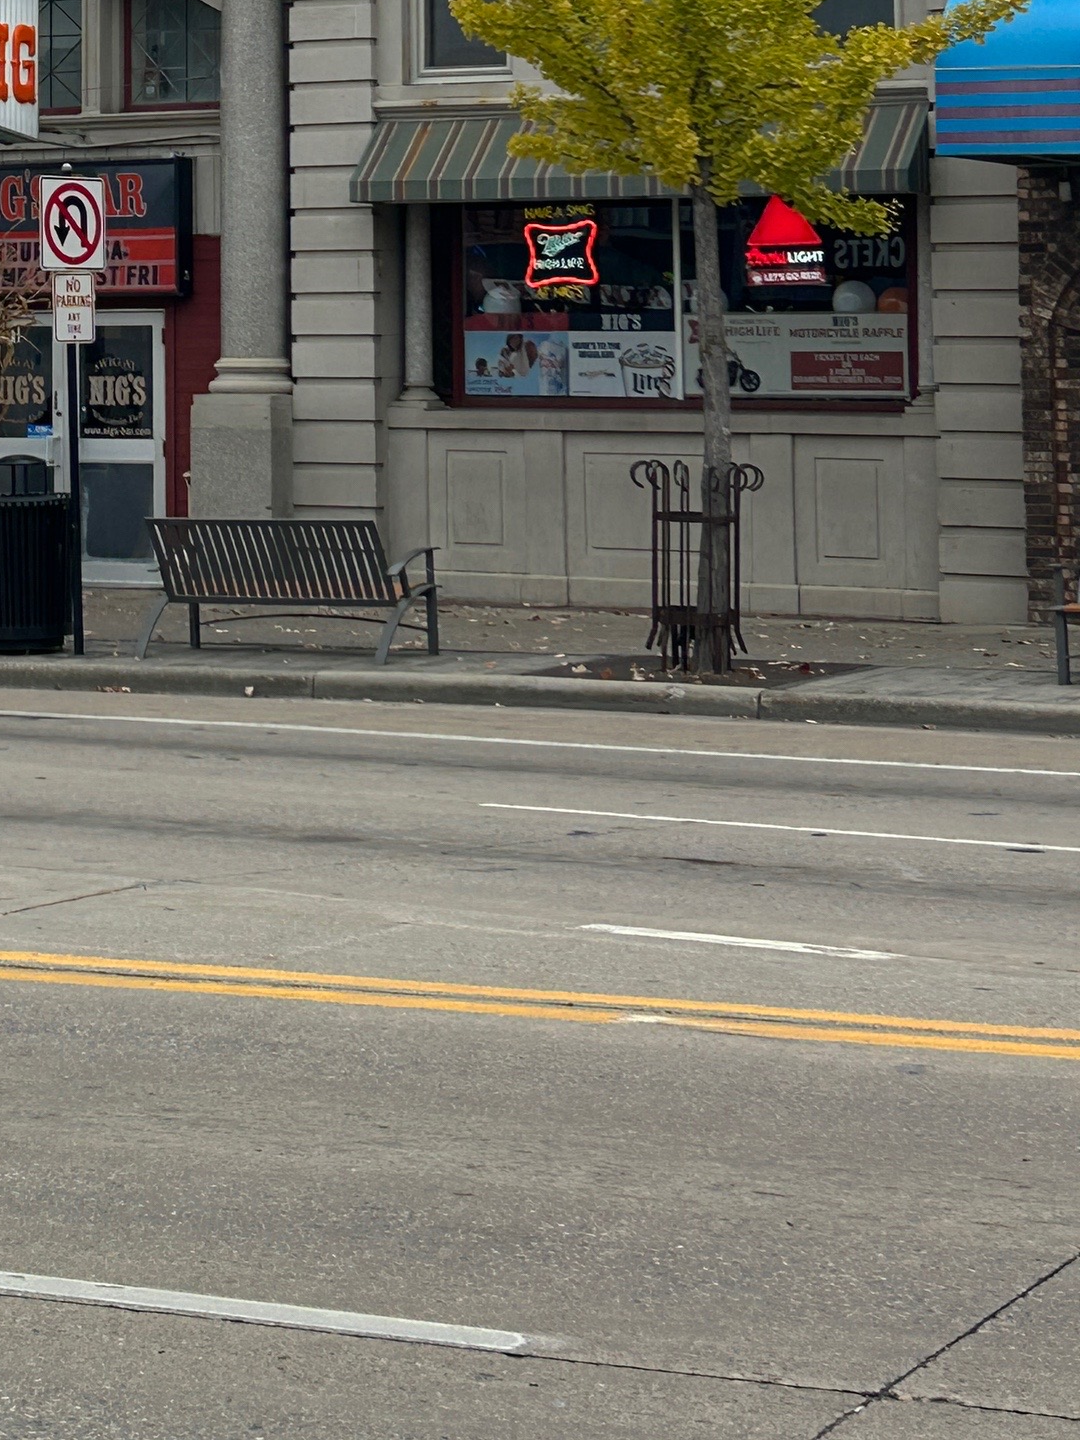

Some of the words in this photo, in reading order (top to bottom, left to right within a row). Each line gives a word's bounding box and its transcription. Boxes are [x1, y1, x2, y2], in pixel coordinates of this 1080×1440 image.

[103, 172, 148, 218] AR
[787, 250, 825, 264] LIGHT
[126, 266, 159, 286] FRI
[65, 279, 81, 293] NO
[56, 295, 92, 308] PARKING
[862, 328, 904, 338] RAFFLE
[88, 373, 147, 406] NIG'S
